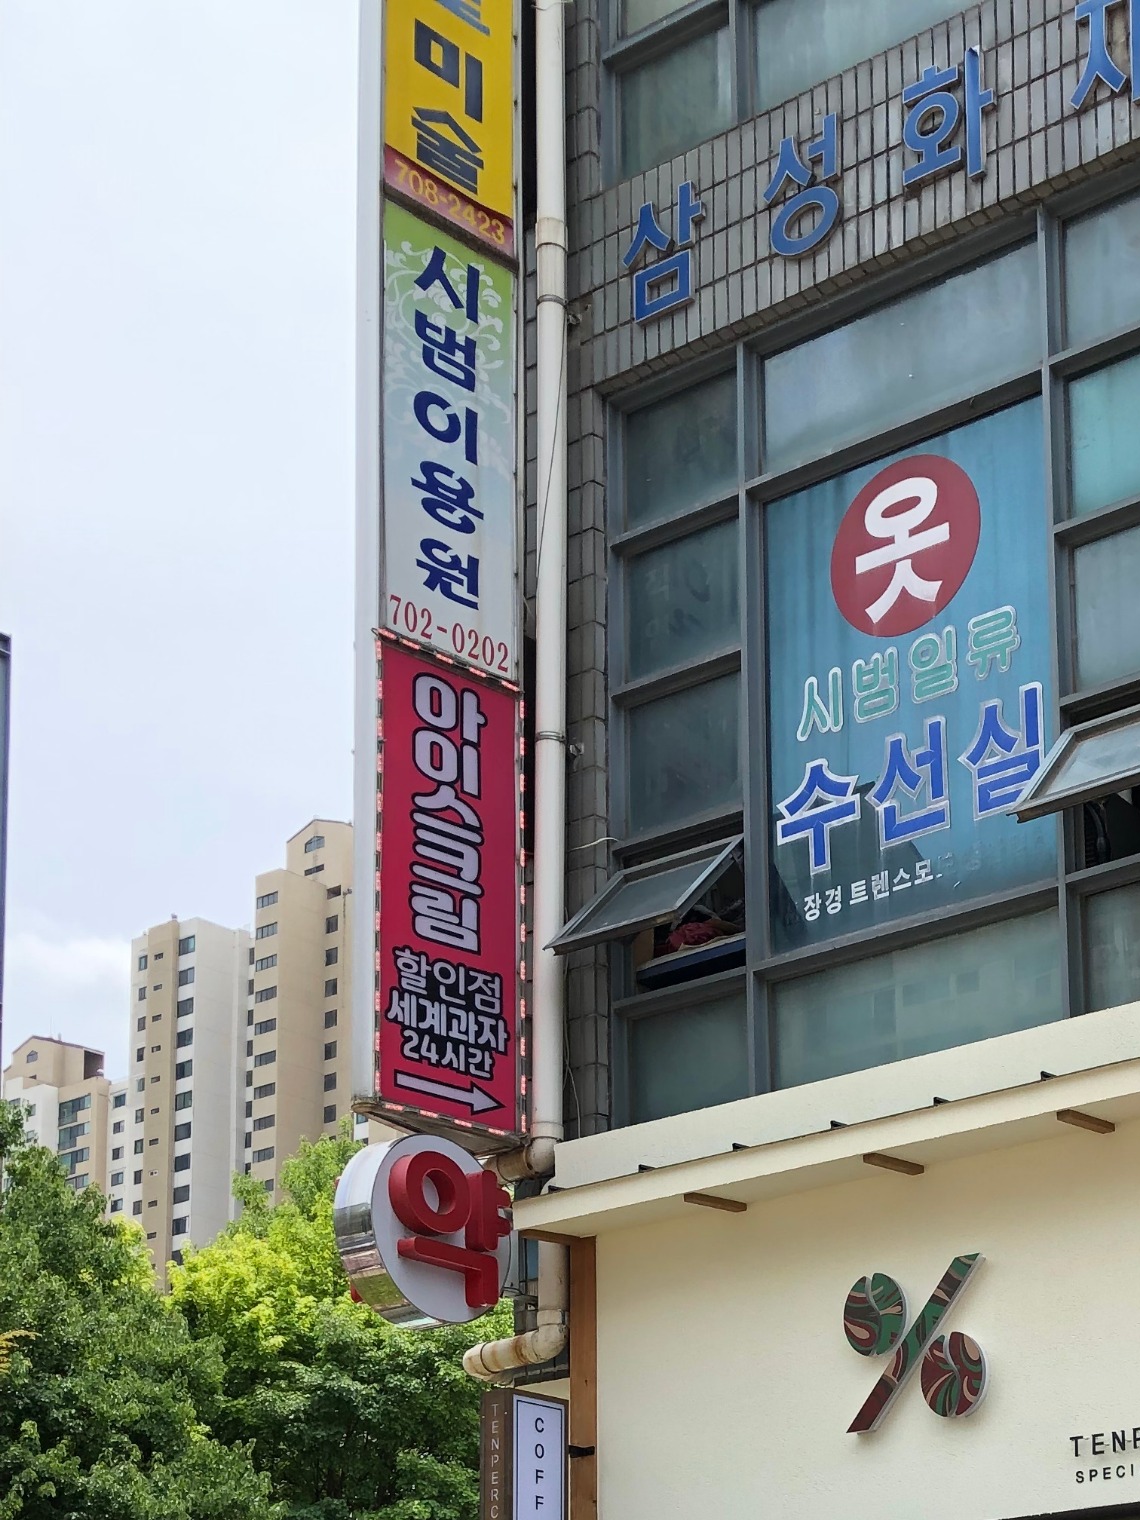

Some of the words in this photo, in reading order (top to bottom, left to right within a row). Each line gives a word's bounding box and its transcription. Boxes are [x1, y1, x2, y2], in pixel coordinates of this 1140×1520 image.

[394, 159, 506, 245] 708-2423
[411, 245, 485, 611] 시범이용원
[855, 476, 950, 625] 옷
[390, 594, 508, 673] 702-0202
[796, 605, 1020, 742] 시범일류
[411, 673, 487, 955] 아이스크림
[776, 681, 1044, 874] 수선실
[387, 990, 508, 1052] 세계과자
[394, 949, 500, 1014] 할인점
[403, 1029, 492, 1078] 24시간
[389, 1150, 511, 1309] 약
